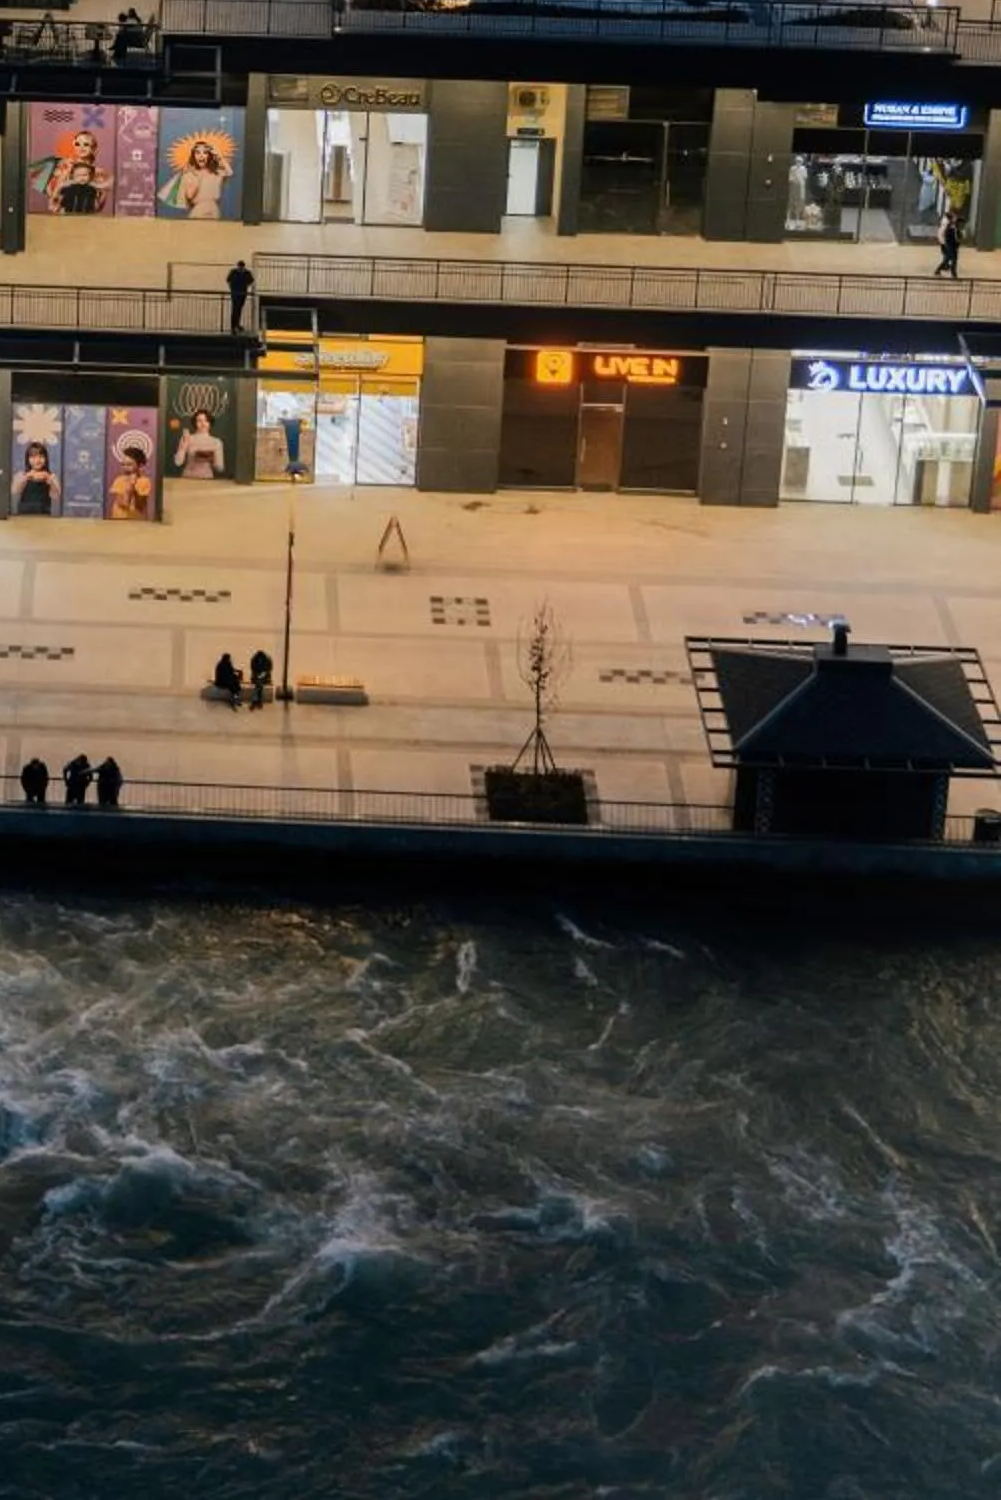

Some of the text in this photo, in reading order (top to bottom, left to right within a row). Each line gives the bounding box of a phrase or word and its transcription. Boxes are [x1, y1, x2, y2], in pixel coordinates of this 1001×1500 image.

[594, 355, 679, 376] LIVE IN
[849, 364, 968, 393] LUXURY
